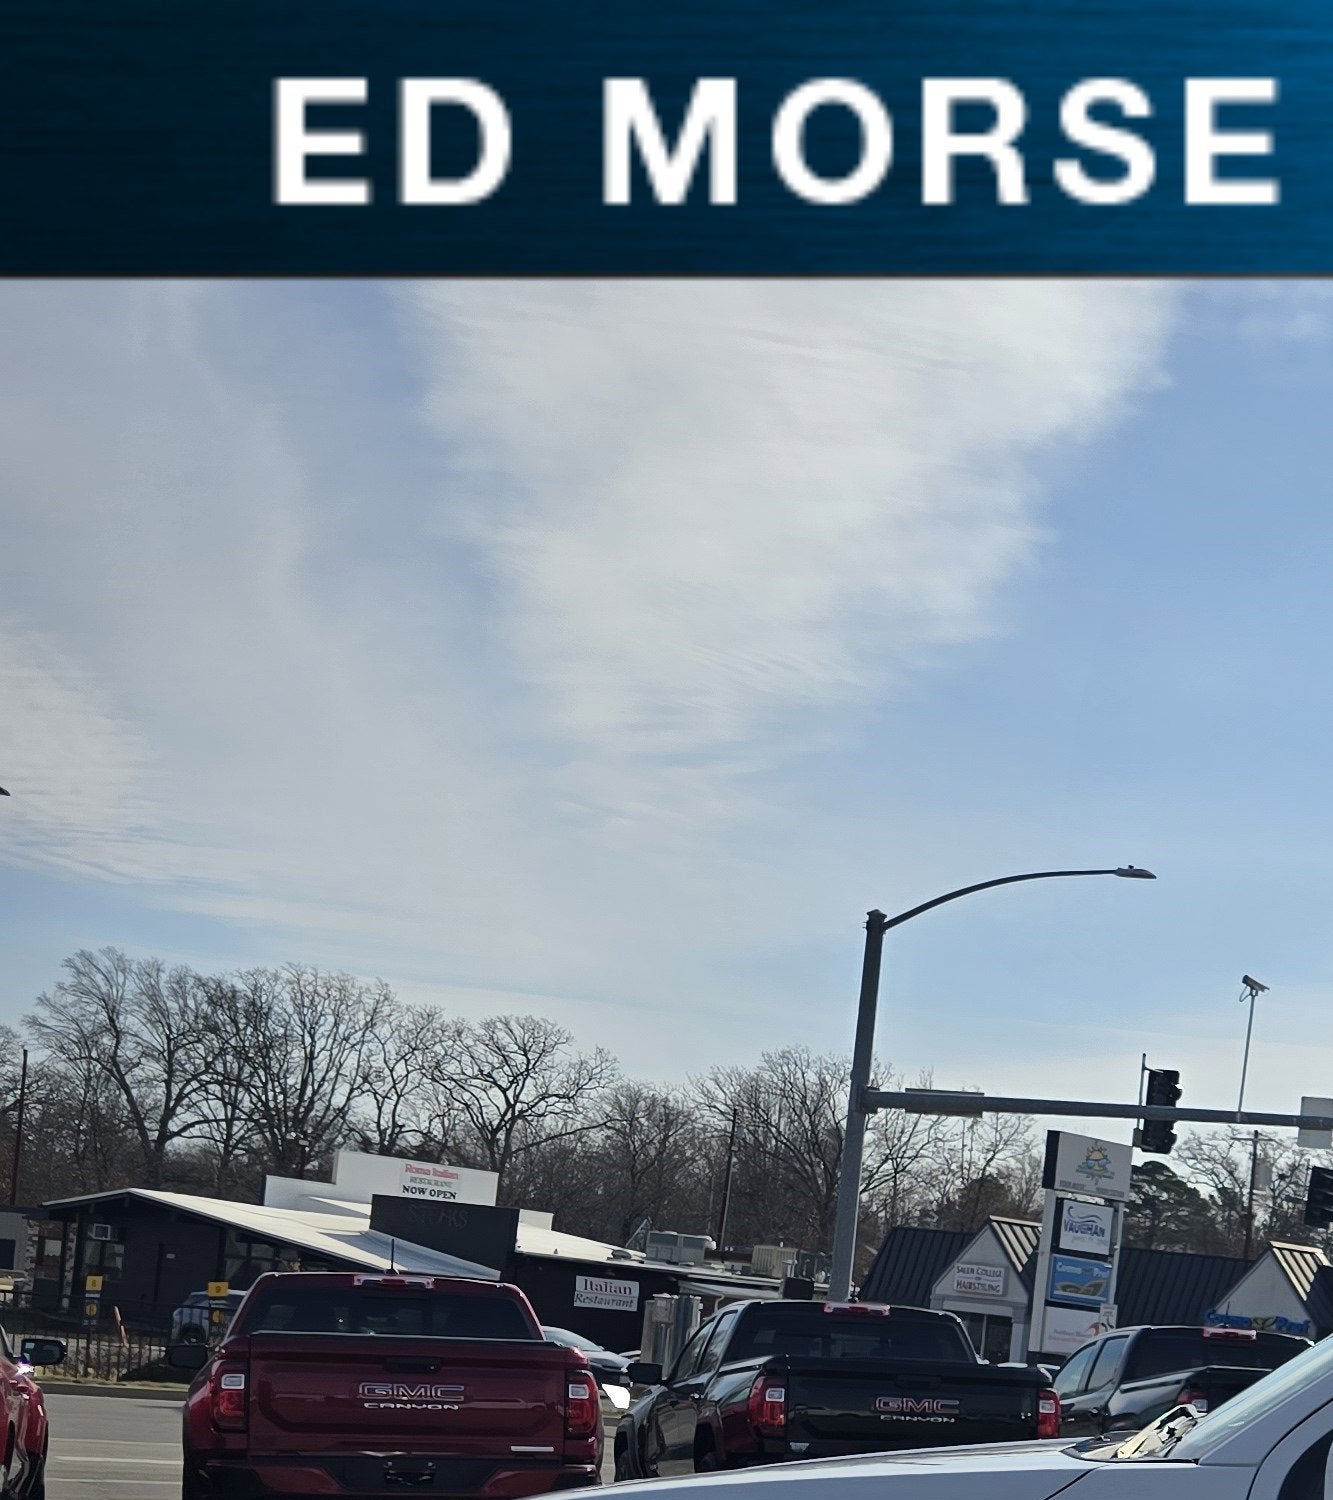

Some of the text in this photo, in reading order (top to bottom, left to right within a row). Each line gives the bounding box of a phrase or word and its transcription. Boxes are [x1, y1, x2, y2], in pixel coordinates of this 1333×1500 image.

[402, 1185, 457, 1200] NOW OPEN
[1063, 1219, 1106, 1238] VAUGHAN
[583, 1278, 633, 1295] Italian
[574, 1293, 634, 1308] Restaurant
[359, 1382, 465, 1401] GMC
[363, 1402, 459, 1410] CANYON
[875, 1396, 960, 1414] GMC
[880, 1414, 956, 1423] CANYON
